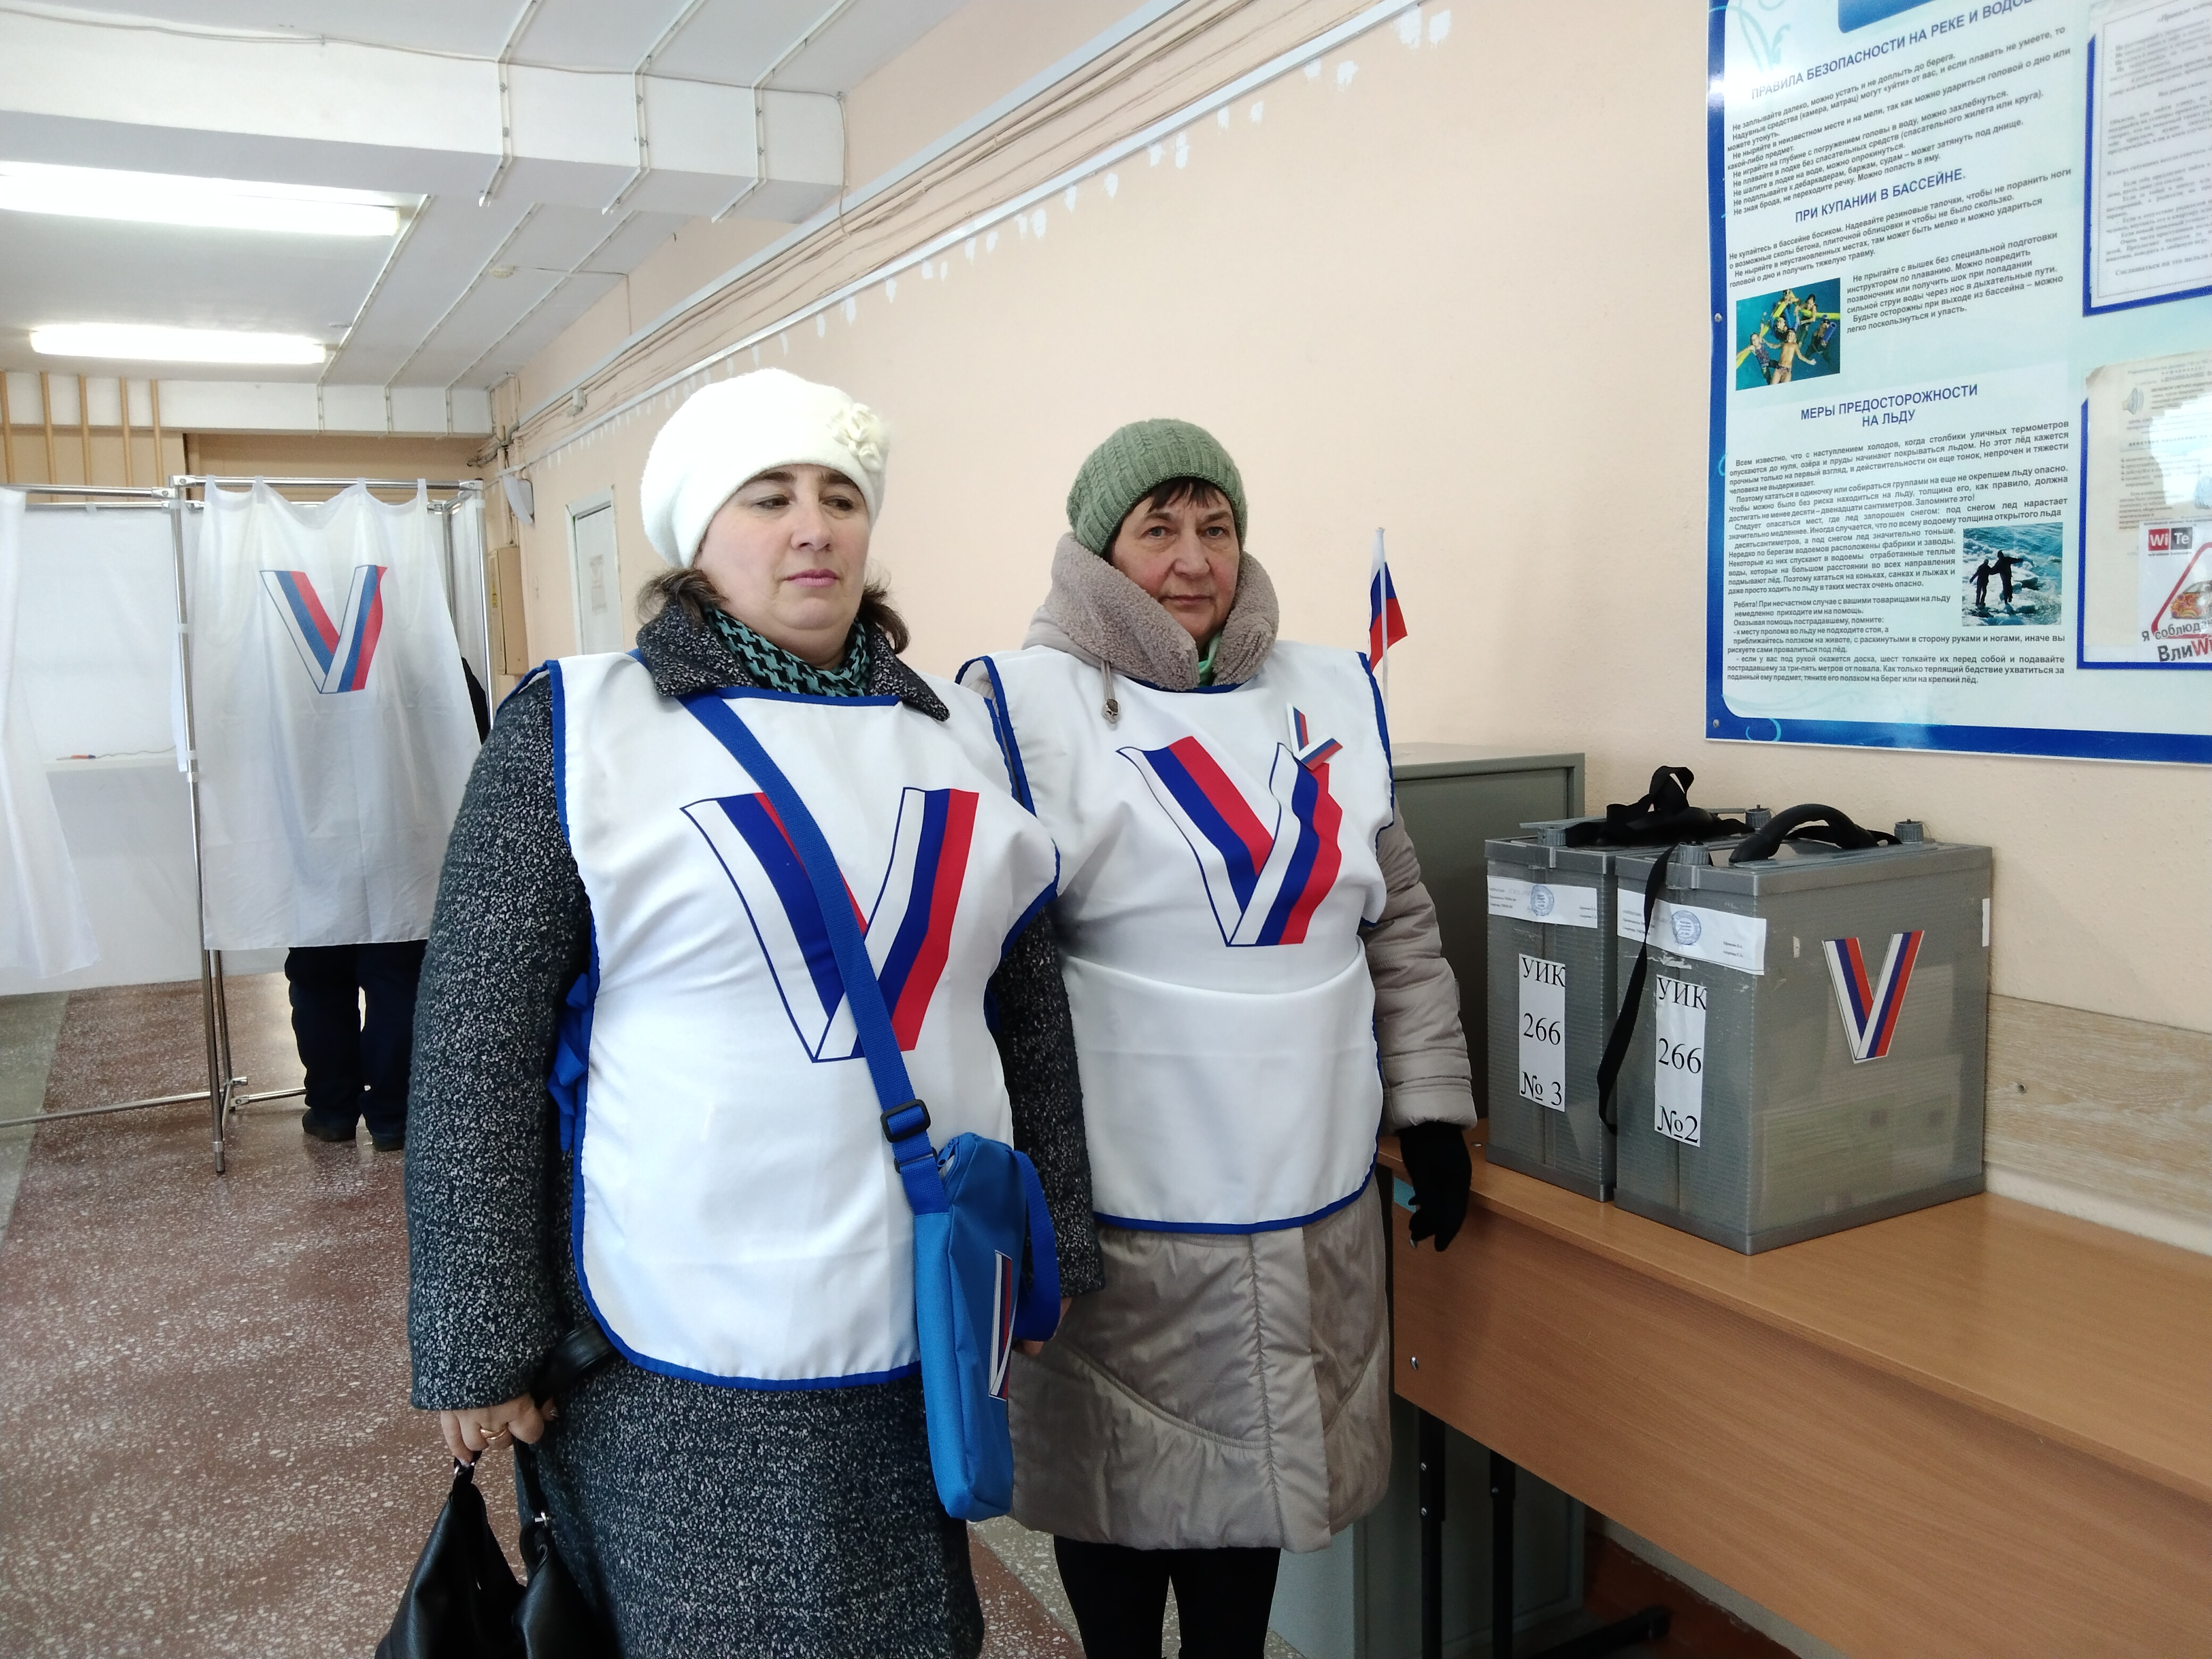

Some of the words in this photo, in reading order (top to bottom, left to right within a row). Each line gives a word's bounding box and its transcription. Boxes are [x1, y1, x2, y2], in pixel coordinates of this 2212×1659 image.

[1752, 72, 1804, 99] ПРАВИЛА
[1807, 35, 1905, 80] БЕЗОПАСНОСТИ
[1909, 28, 1927, 45] НА
[1931, 14, 1964, 37] РЕКЕ
[1969, 9, 1978, 23] И
[1732, 125, 1766, 141] Надувные
[1767, 115, 1798, 130] средства
[1799, 106, 1829, 121] (камера,
[1830, 94, 1858, 109] матрац)
[1860, 87, 1882, 99] могут
[1883, 79, 1909, 93] «уйти»
[1922, 70, 1938, 79] вас,
[1947, 59, 1967, 71] если
[1968, 48, 2004, 64] плавать
[2006, 43, 2016, 52] не
[2018, 31, 2052, 49] умеете,
[1742, 110, 1781, 128] заплывайте
[1782, 102, 1809, 115] далеко,
[1811, 93, 1833, 105] можно
[1834, 86, 1859, 99] устать
[1878, 68, 1912, 85] доплыть
[1914, 63, 1924, 73] до
[1926, 53, 1955, 67] берега.
[1743, 182, 1767, 194] шалите
[1774, 174, 1795, 185] лодке
[1805, 166, 1824, 176] воде,
[1826, 158, 1849, 170] можно
[1851, 143, 1905, 163] опрокинуться.
[1743, 204, 1758, 213] зная
[1759, 198, 1781, 209] брода,
[1792, 183, 1832, 199] переходите
[1834, 177, 1855, 189] речку.
[1857, 170, 1882, 181] Можно
[1884, 161, 1915, 174] попасть
[1924, 153, 1940, 163] яму.
[1795, 206, 1817, 223] ПРИ
[1821, 190, 1876, 216] КУПАНИИ
[1880, 188, 1888, 200] В
[1892, 167, 1965, 197] БАССЕЙНЕ.
[1738, 245, 1772, 258] купайтесь
[1779, 234, 1810, 247] бассейне
[1812, 227, 1843, 239] босиком.
[1845, 216, 1884, 231] Надевайте
[1886, 205, 1928, 222] резиновые
[1929, 196, 1964, 209] тапочки,
[1966, 188, 1992, 200] чтобы
[2007, 175, 2048, 190] поранить
[2050, 169, 2071, 179] ноги
[1847, 277, 1898, 294] инструктором
[1911, 266, 1953, 280] плаванию.
[1955, 259, 1982, 271] Можно
[1984, 249, 2031, 264] повредить
[1864, 267, 1899, 281] прыгайте
[1907, 259, 1933, 271] вышек
[1935, 256, 1949, 264] без
[1950, 242, 2005, 261] специальной
[2007, 232, 2057, 248] подготовки
[1847, 289, 1894, 304] позвоночник
[1896, 285, 1910, 294] или
[1912, 278, 1949, 290] получить
[1950, 273, 1967, 282] шок
[1968, 270, 1984, 279] при
[1985, 260, 2032, 275] попадании
[1846, 324, 1866, 333] легко
[1868, 312, 1929, 329] поскользнуться
[1937, 306, 1967, 318] упасть.
[1800, 405, 1835, 420] МЕРЫ
[1839, 383, 1978, 414] ПРЕДОСТОРОЖНОСТИ
[1862, 414, 1879, 427] НА
[1881, 409, 1915, 424] ЛЬДУ
[1755, 455, 1787, 464] известно,
[1813, 446, 1863, 457] наступлением
[1867, 441, 1900, 450] холодов,
[1929, 433, 1966, 443] столбики
[1970, 428, 2007, 440] уличных
[2010, 421, 2069, 434] термометров
[1789, 556, 1822, 565] спускают
[1870, 550, 1923, 560] отработанные
[2150, 533, 2168, 547] Wi
[2174, 532, 2189, 545] Te
[1826, 563, 1868, 572] расстоянии
[1904, 558, 1955, 568] направления
[1777, 609, 1812, 617] приходите
[2141, 630, 2150, 642] Я
[1521, 957, 1565, 987] УИК
[1657, 977, 1707, 1010] УИК
[1523, 1012, 1561, 1045] 266
[1658, 1038, 1702, 1074] 266
[1551, 1081, 1562, 1106] 3
